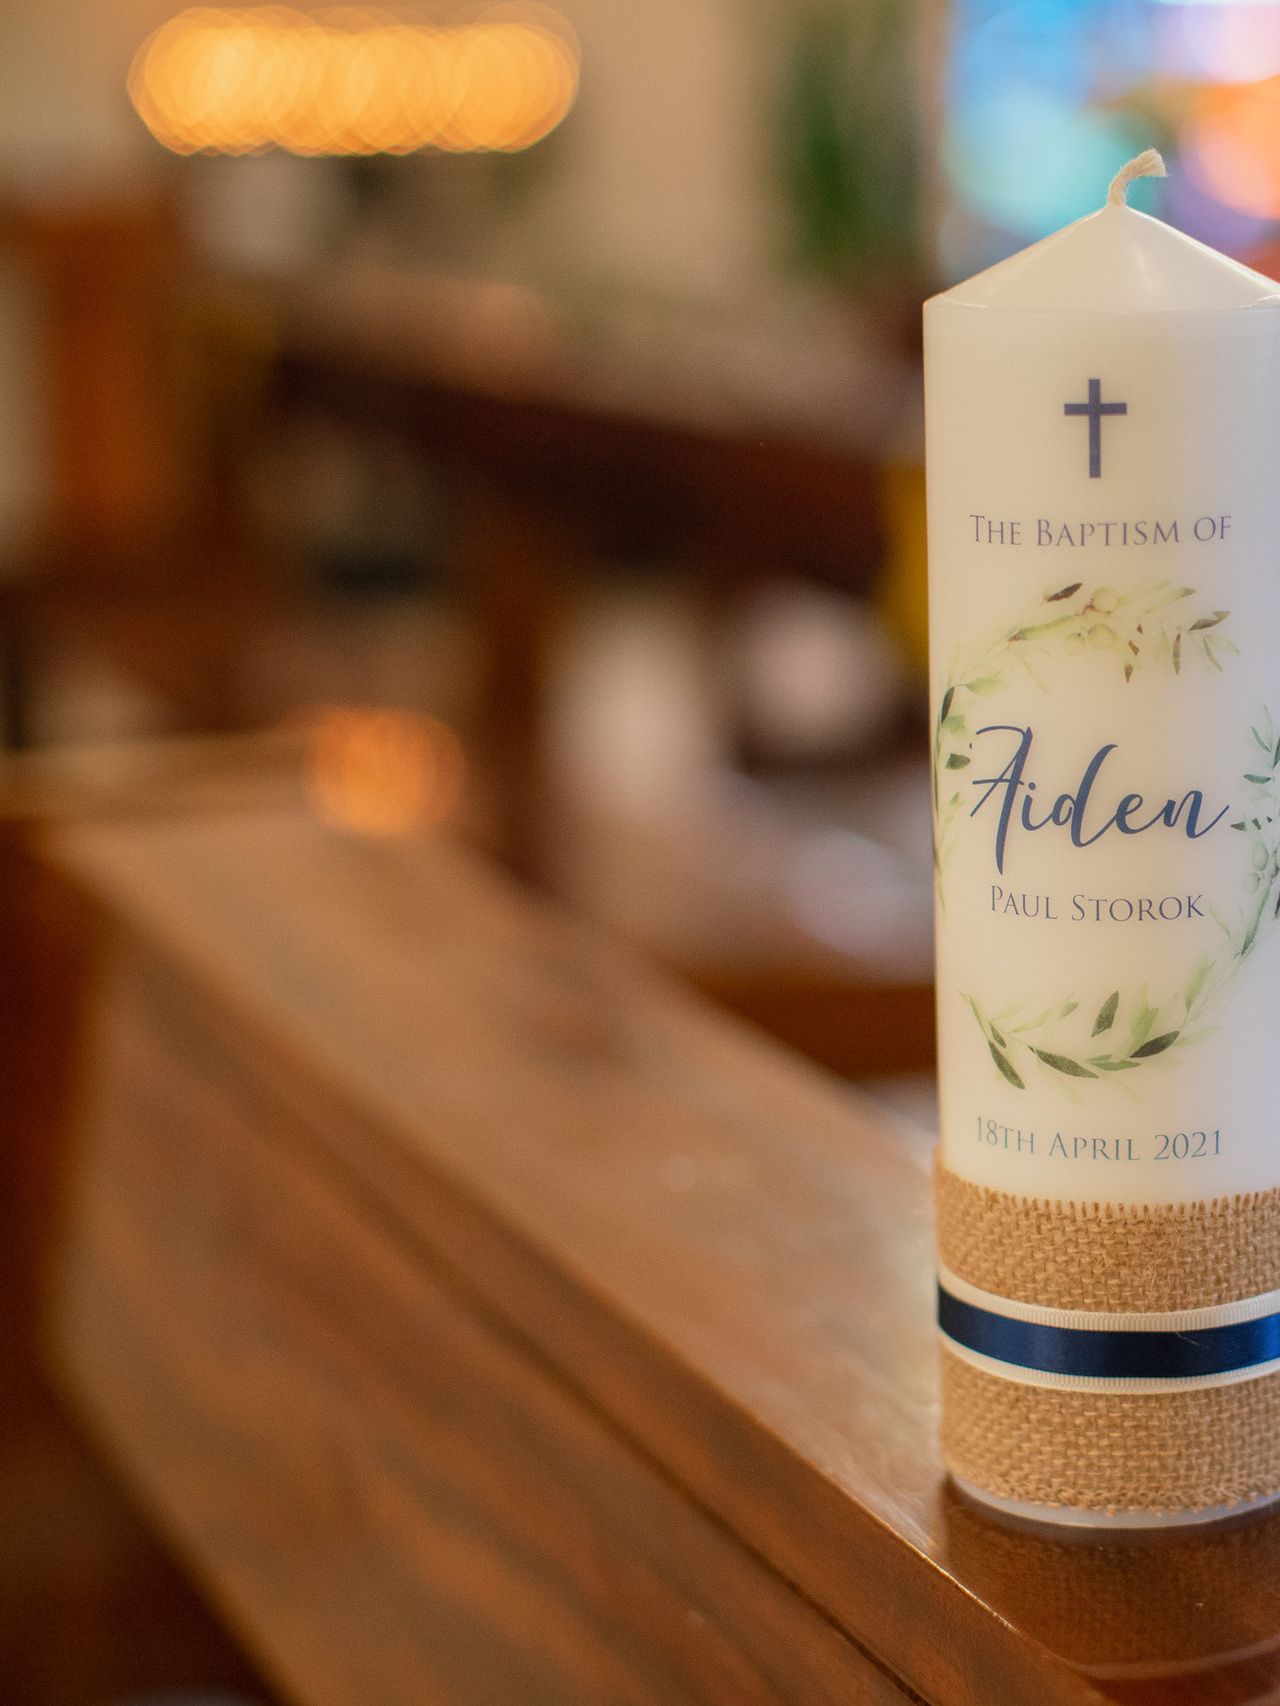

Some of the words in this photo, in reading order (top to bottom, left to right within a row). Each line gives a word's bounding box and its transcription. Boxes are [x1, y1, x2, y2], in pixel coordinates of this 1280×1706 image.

[970, 725, 1230, 875] Aiden
[990, 884, 1058, 920] PAUL
[1071, 893, 1205, 923] STOROK
[975, 1115, 1035, 1155] 18TH
[1048, 1131, 1141, 1162] APRIL
[1153, 1128, 1222, 1161] 2021
